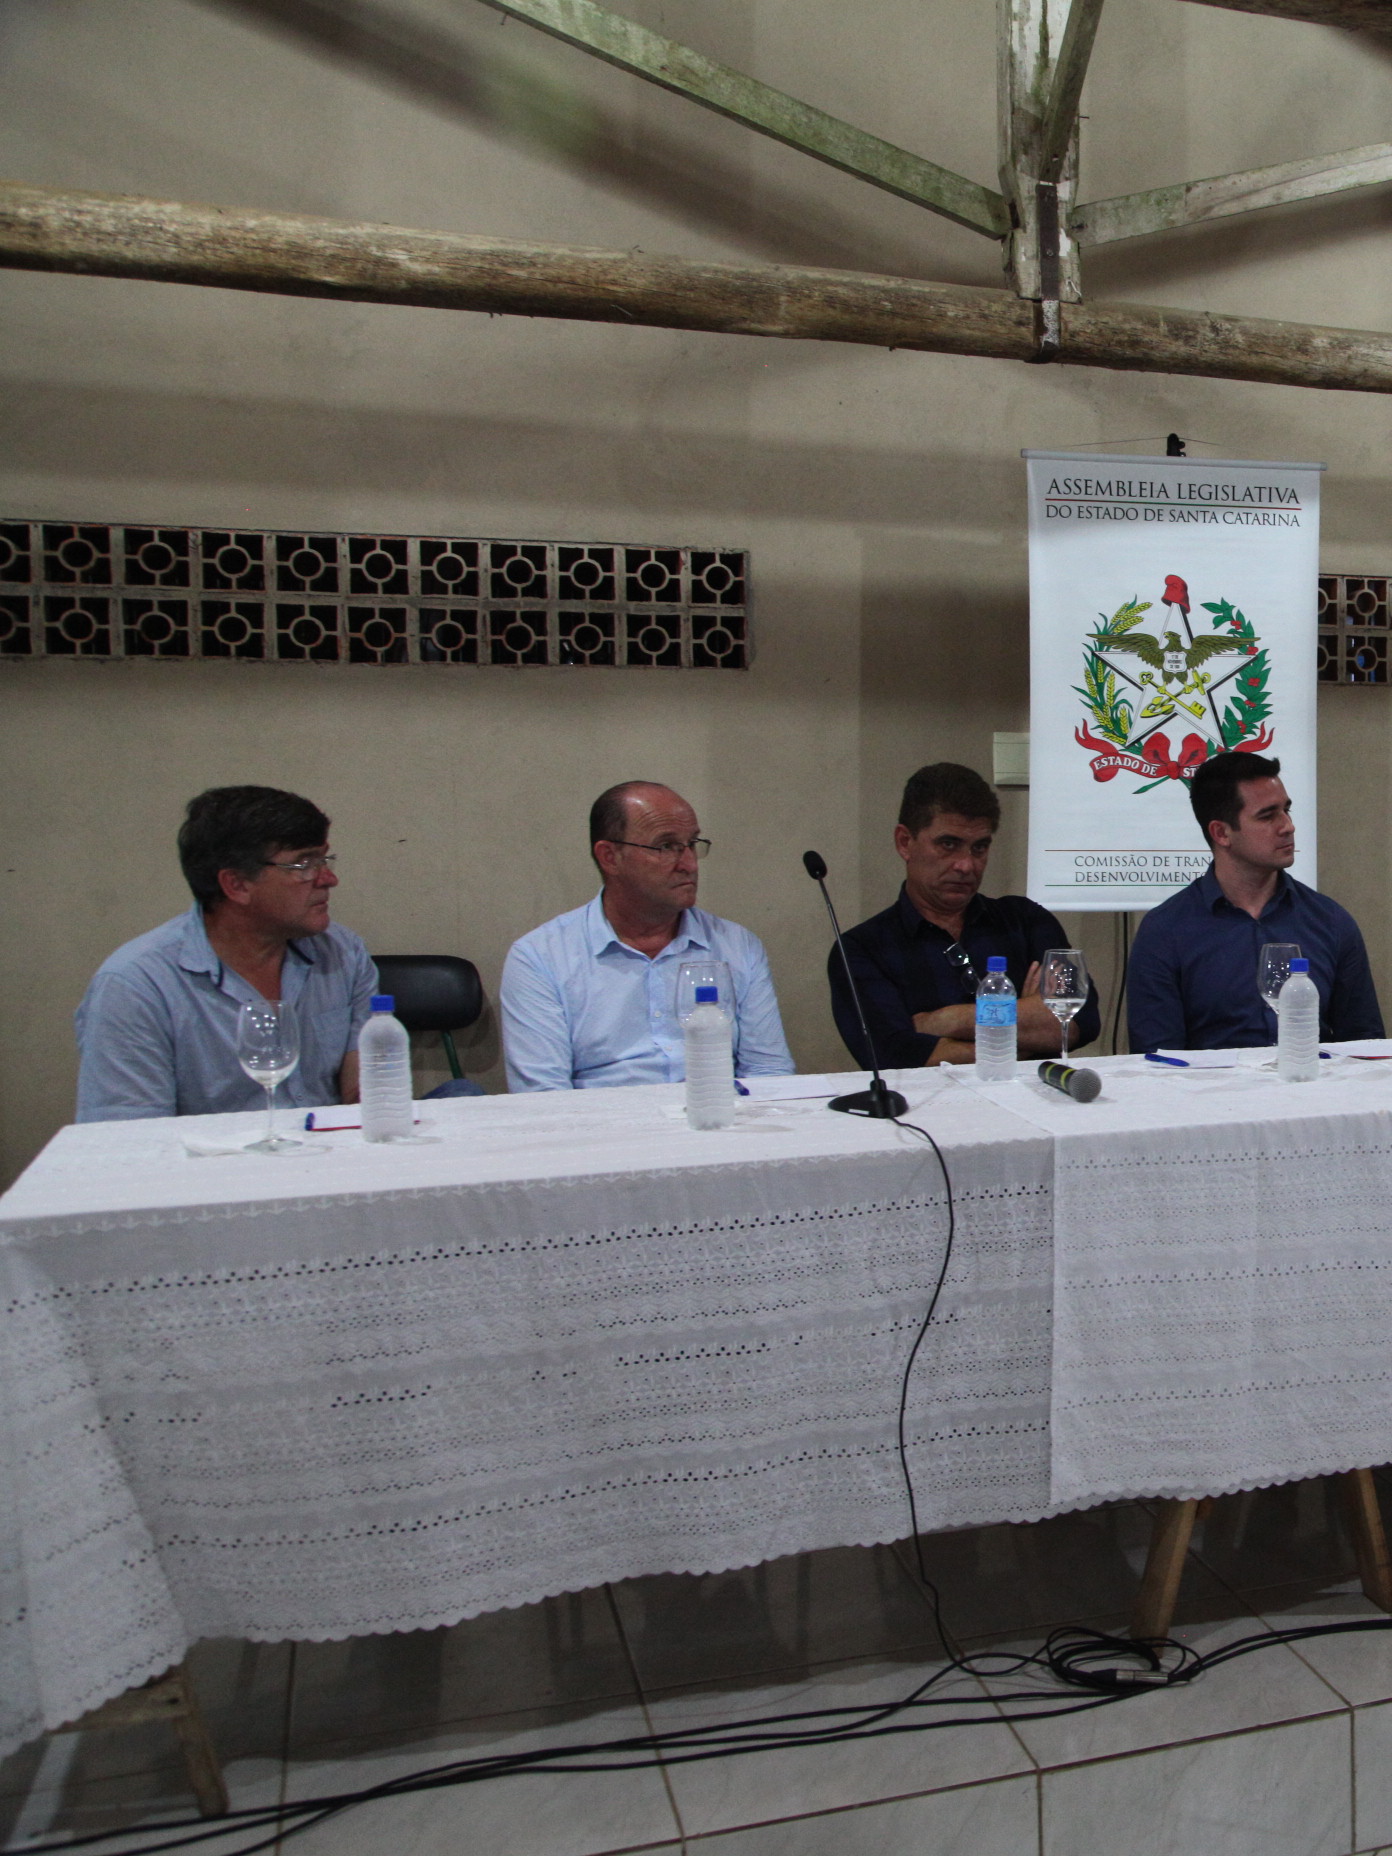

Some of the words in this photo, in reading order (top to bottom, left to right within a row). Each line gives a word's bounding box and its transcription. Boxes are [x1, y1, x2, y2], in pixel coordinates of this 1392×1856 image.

[1046, 478, 1170, 498] ASSEMBLEIA
[1176, 482, 1300, 504] LEGISLATIVA
[1046, 504, 1072, 519] DO
[1077, 505, 1139, 521] ESTADO
[1144, 508, 1164, 522] DE
[1168, 509, 1219, 525] SANTA
[1222, 511, 1300, 527] CATARINA
[1093, 756, 1140, 771] ESTADO
[1141, 764, 1158, 776] DE
[1183, 767, 1197, 777] ST
[1074, 854, 1148, 867] COMISSÃO
[1152, 855, 1170, 867] DE
[1174, 856, 1212, 867] TRAN
